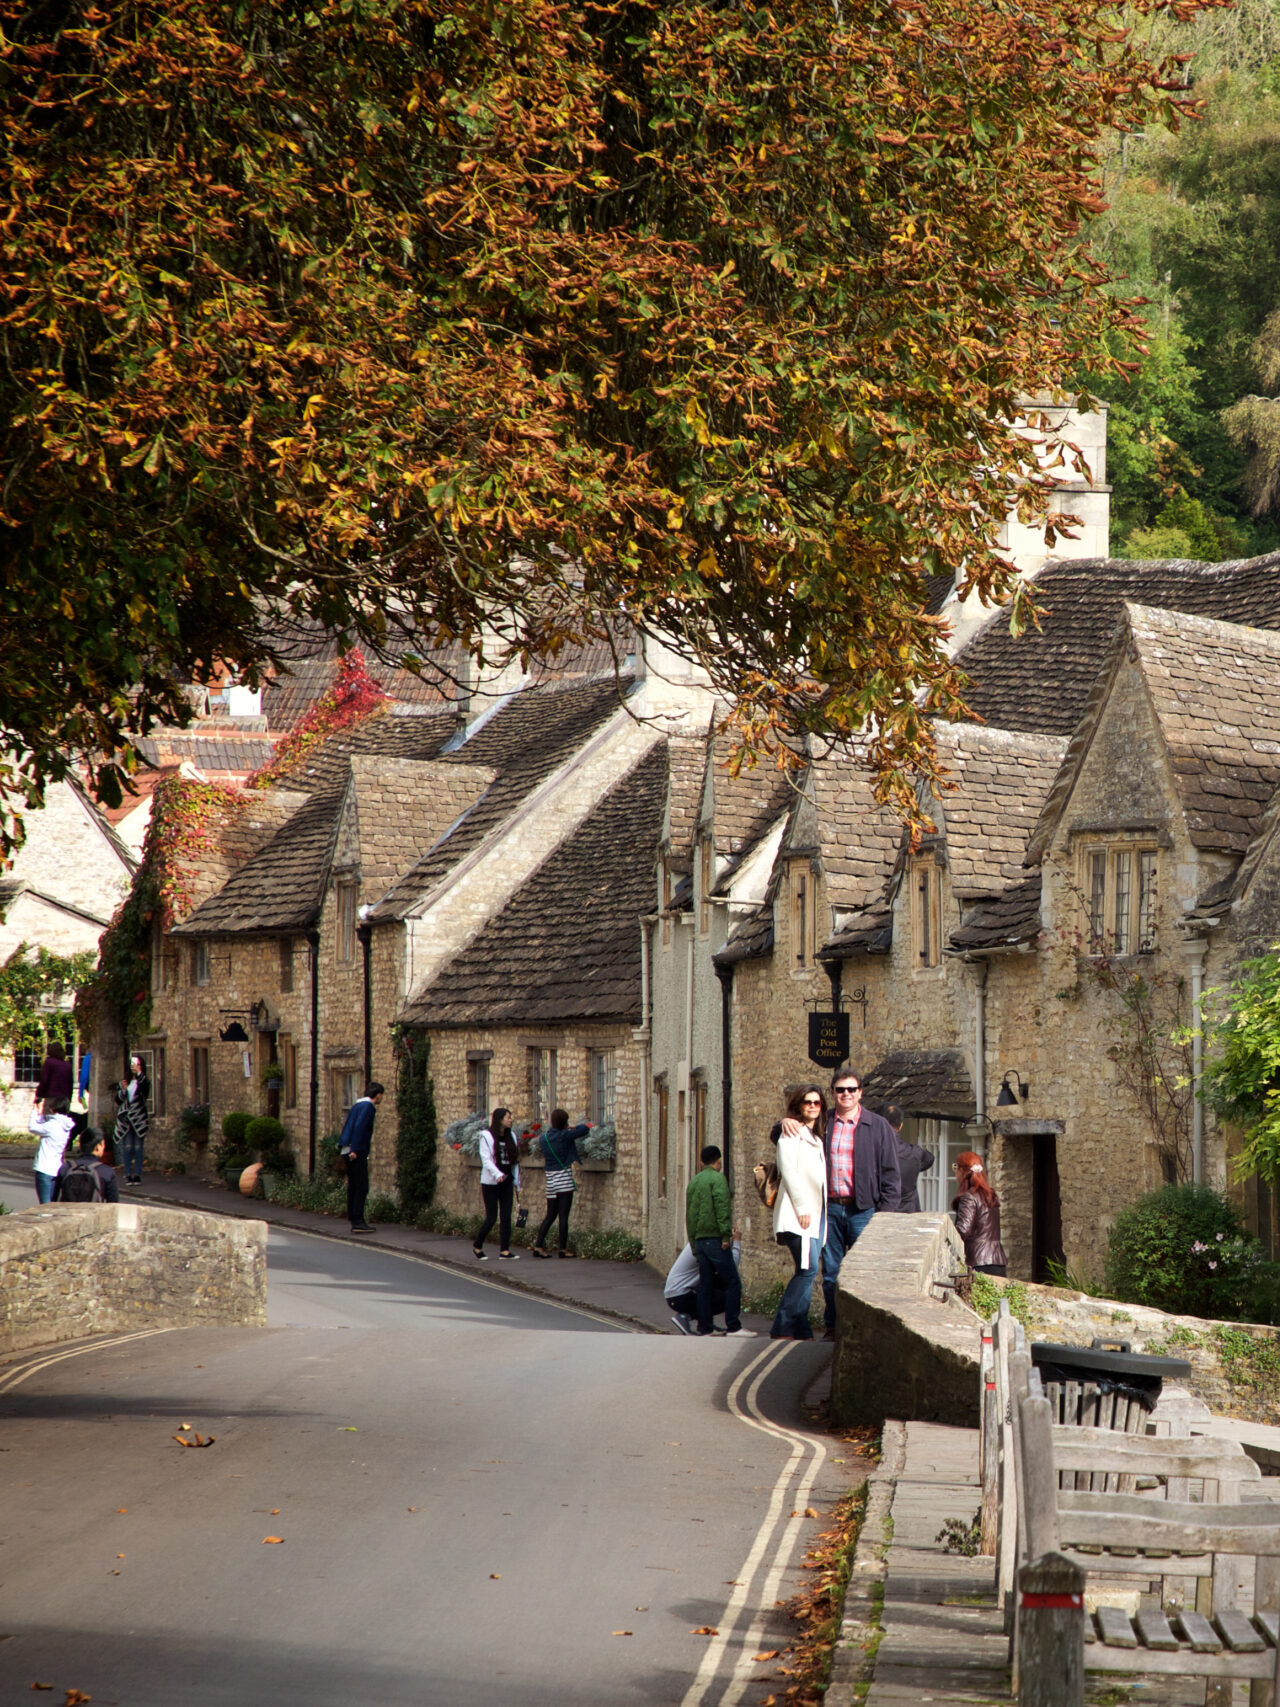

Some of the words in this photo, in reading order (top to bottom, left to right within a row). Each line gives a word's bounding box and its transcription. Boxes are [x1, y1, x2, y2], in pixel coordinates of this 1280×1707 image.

[820, 1018, 837, 1027] The
[820, 1028, 837, 1037] Old
[820, 1039, 838, 1047] Post
[816, 1048, 842, 1057] Office
